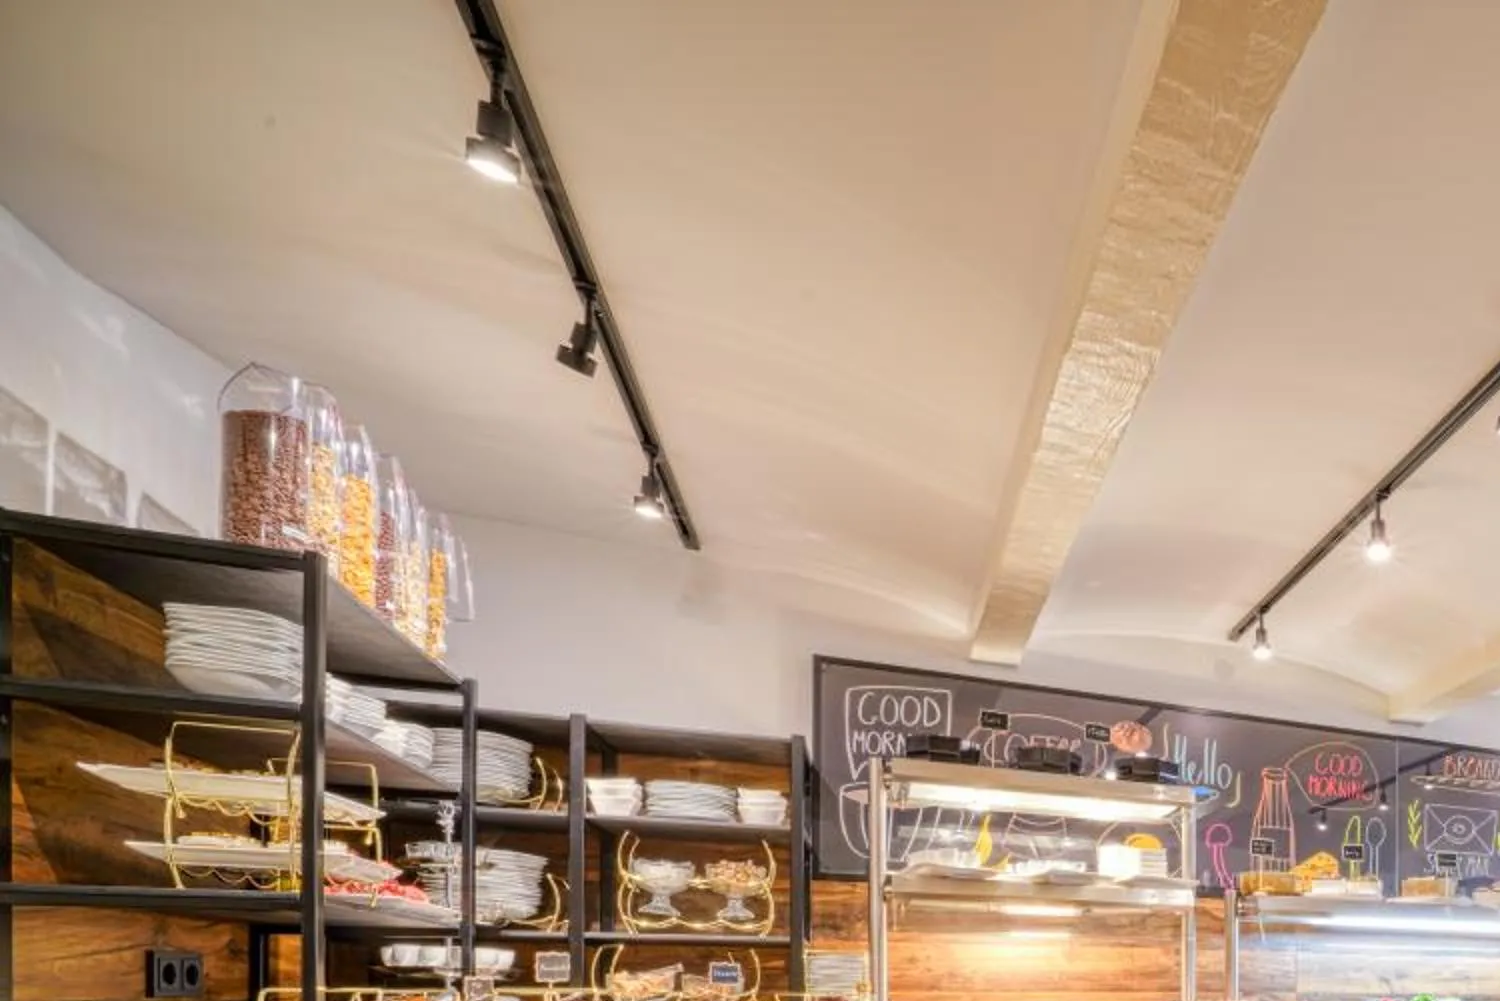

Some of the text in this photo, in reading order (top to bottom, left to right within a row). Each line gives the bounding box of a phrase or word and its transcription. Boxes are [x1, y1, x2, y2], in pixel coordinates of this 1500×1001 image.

[857, 691, 942, 728] GOOD
[852, 730, 909, 757] MORN
[1174, 732, 1233, 790] Hello
[1314, 751, 1364, 778] GOOD
